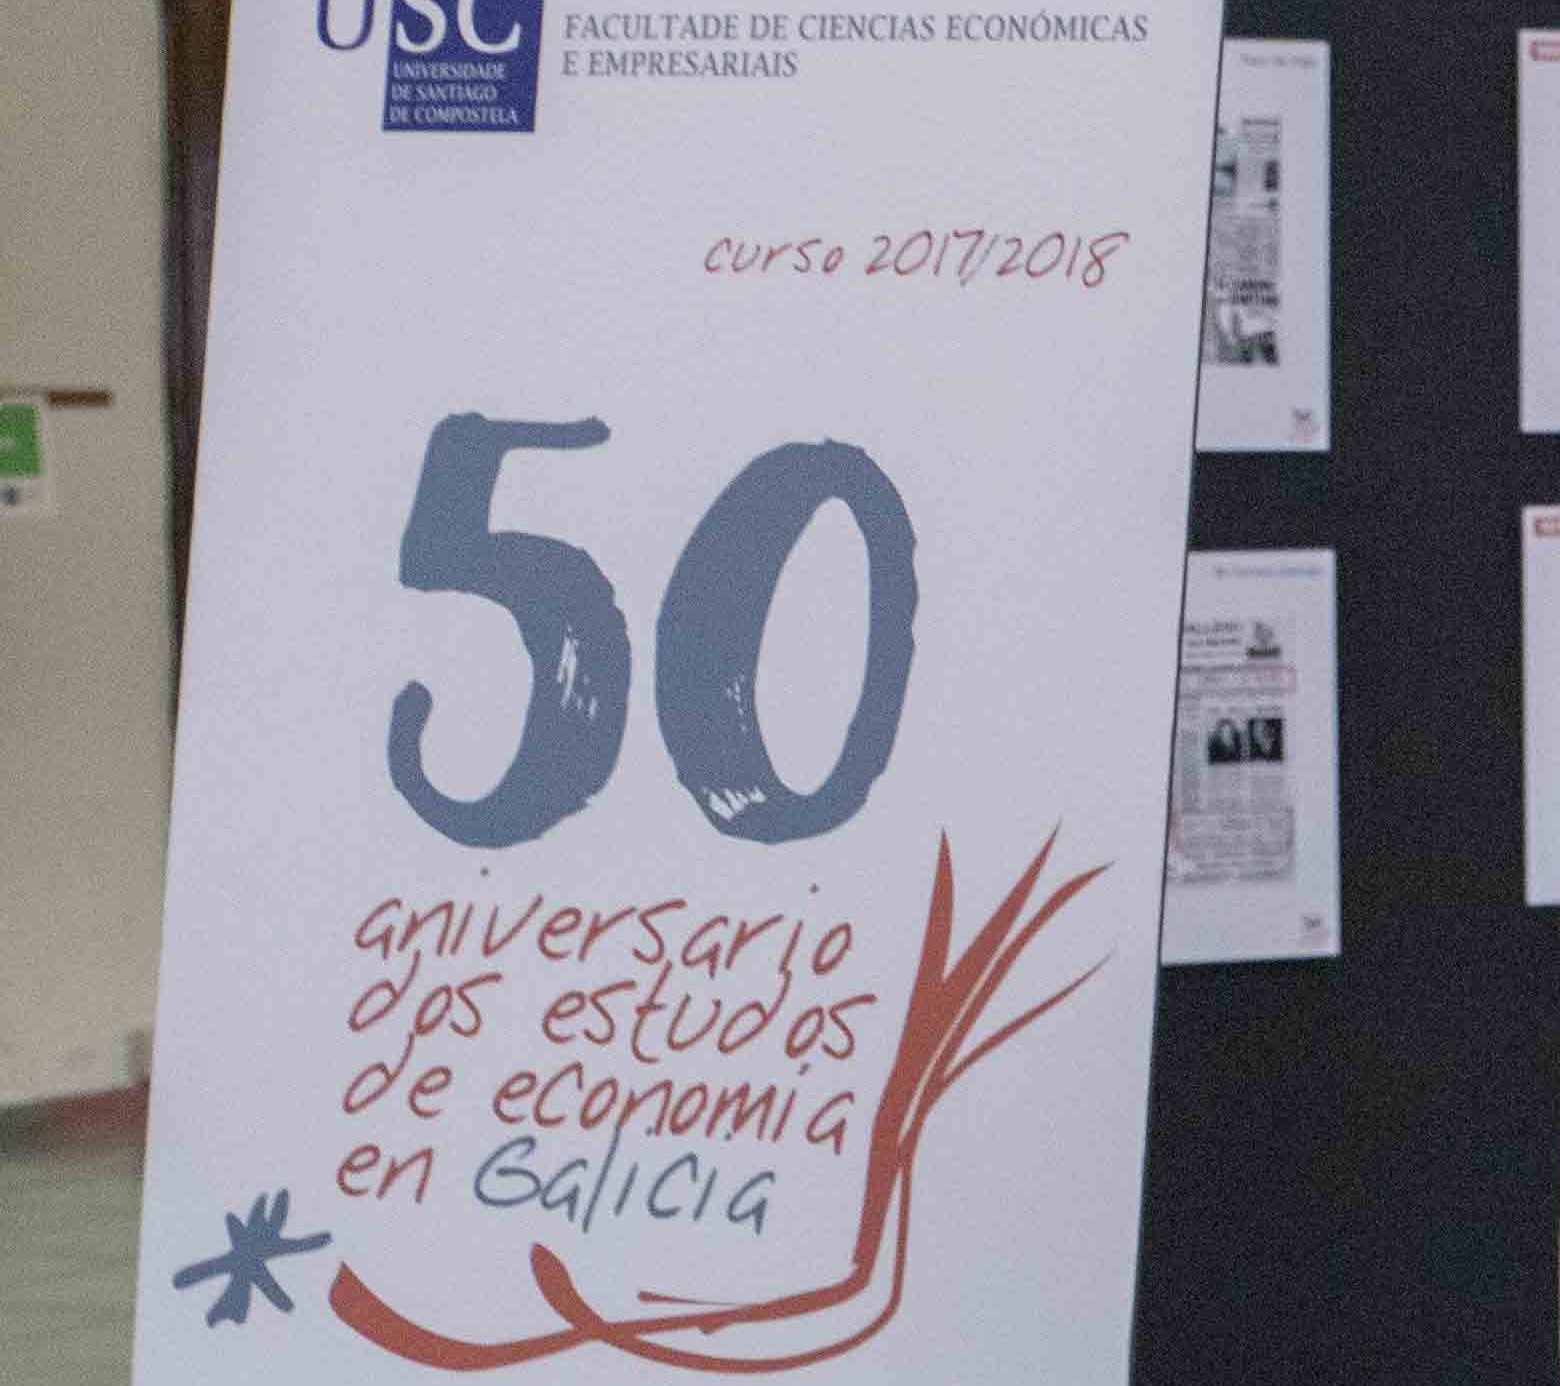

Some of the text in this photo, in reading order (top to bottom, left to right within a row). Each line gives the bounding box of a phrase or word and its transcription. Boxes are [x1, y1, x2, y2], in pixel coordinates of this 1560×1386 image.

[564, 8, 1149, 42] FACULTADE DE CIENCIAS ECONÓMICAS
[393, 63, 505, 80] UNIVERSIDADE
[561, 51, 798, 78] E EMPRESARIAIS
[389, 108, 519, 126] DE COMPOSTELA
[391, 86, 497, 103] DE SANTIAGO
[704, 228, 1130, 287] curso 2017/2018
[388, 410, 919, 849] 50
[354, 868, 853, 975] aniversario
[347, 950, 878, 1064] dos estudos
[343, 1033, 454, 1119] de
[338, 1125, 777, 1235] en Galicia
